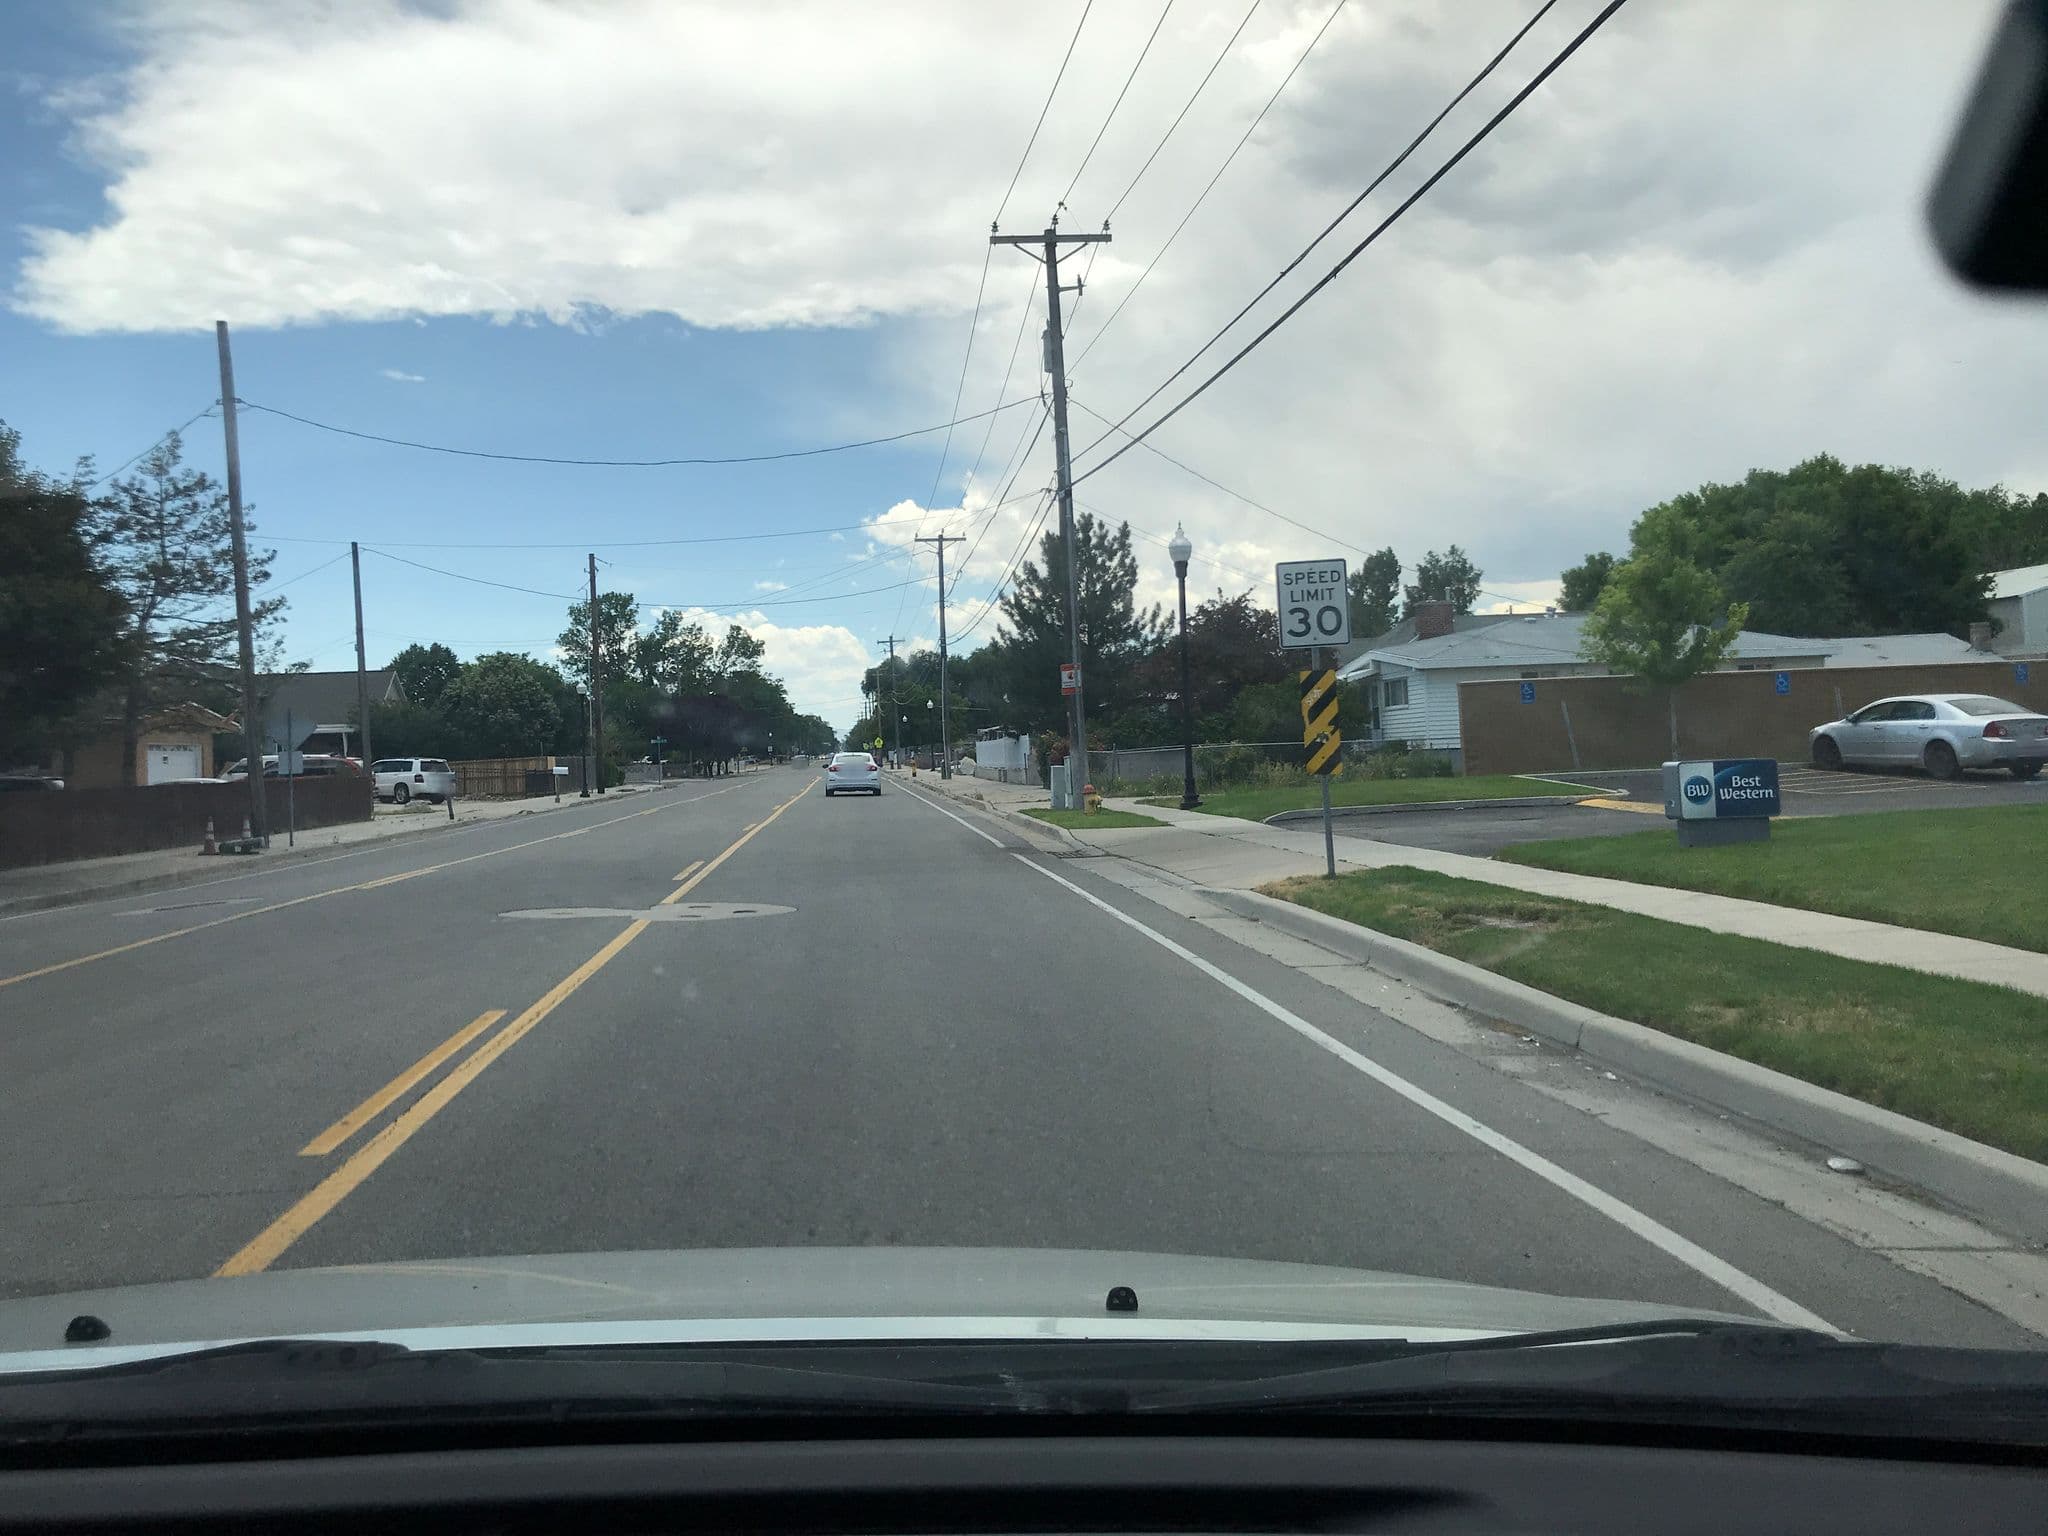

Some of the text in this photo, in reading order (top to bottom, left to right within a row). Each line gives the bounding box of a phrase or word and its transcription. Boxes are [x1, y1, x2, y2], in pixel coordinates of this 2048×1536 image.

[1283, 570, 1341, 586] SPEED
[1290, 587, 1336, 603] LIMIT
[1287, 605, 1342, 638] 30
[1731, 775, 1761, 788] Best
[1687, 784, 1709, 797] BW
[1719, 788, 1774, 800] Western
